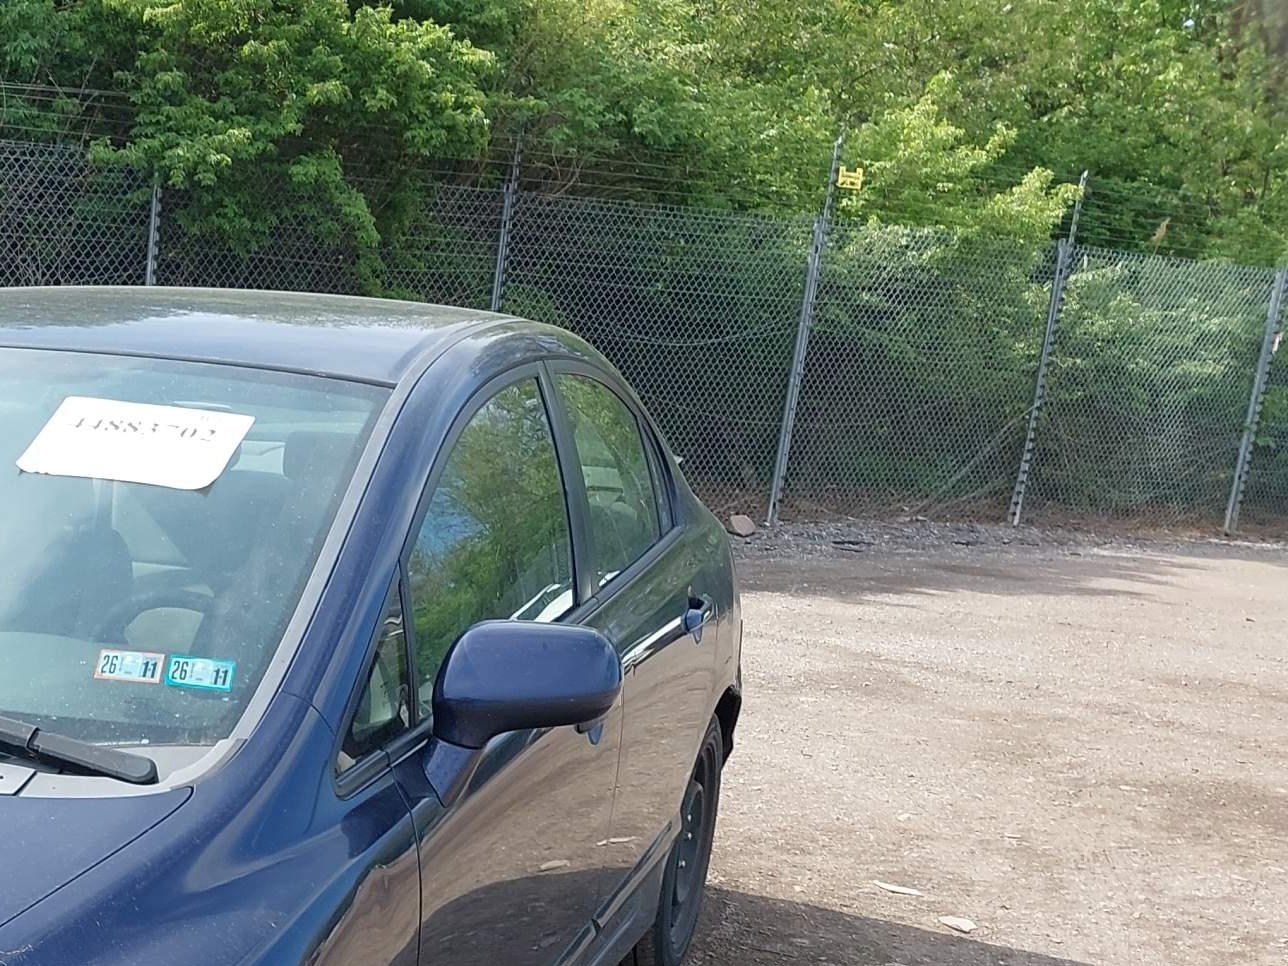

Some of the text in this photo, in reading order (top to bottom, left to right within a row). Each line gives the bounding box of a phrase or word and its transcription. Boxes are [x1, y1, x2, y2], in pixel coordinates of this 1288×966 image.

[101, 654, 158, 679] 26 11
[171, 660, 229, 686] 26 11
